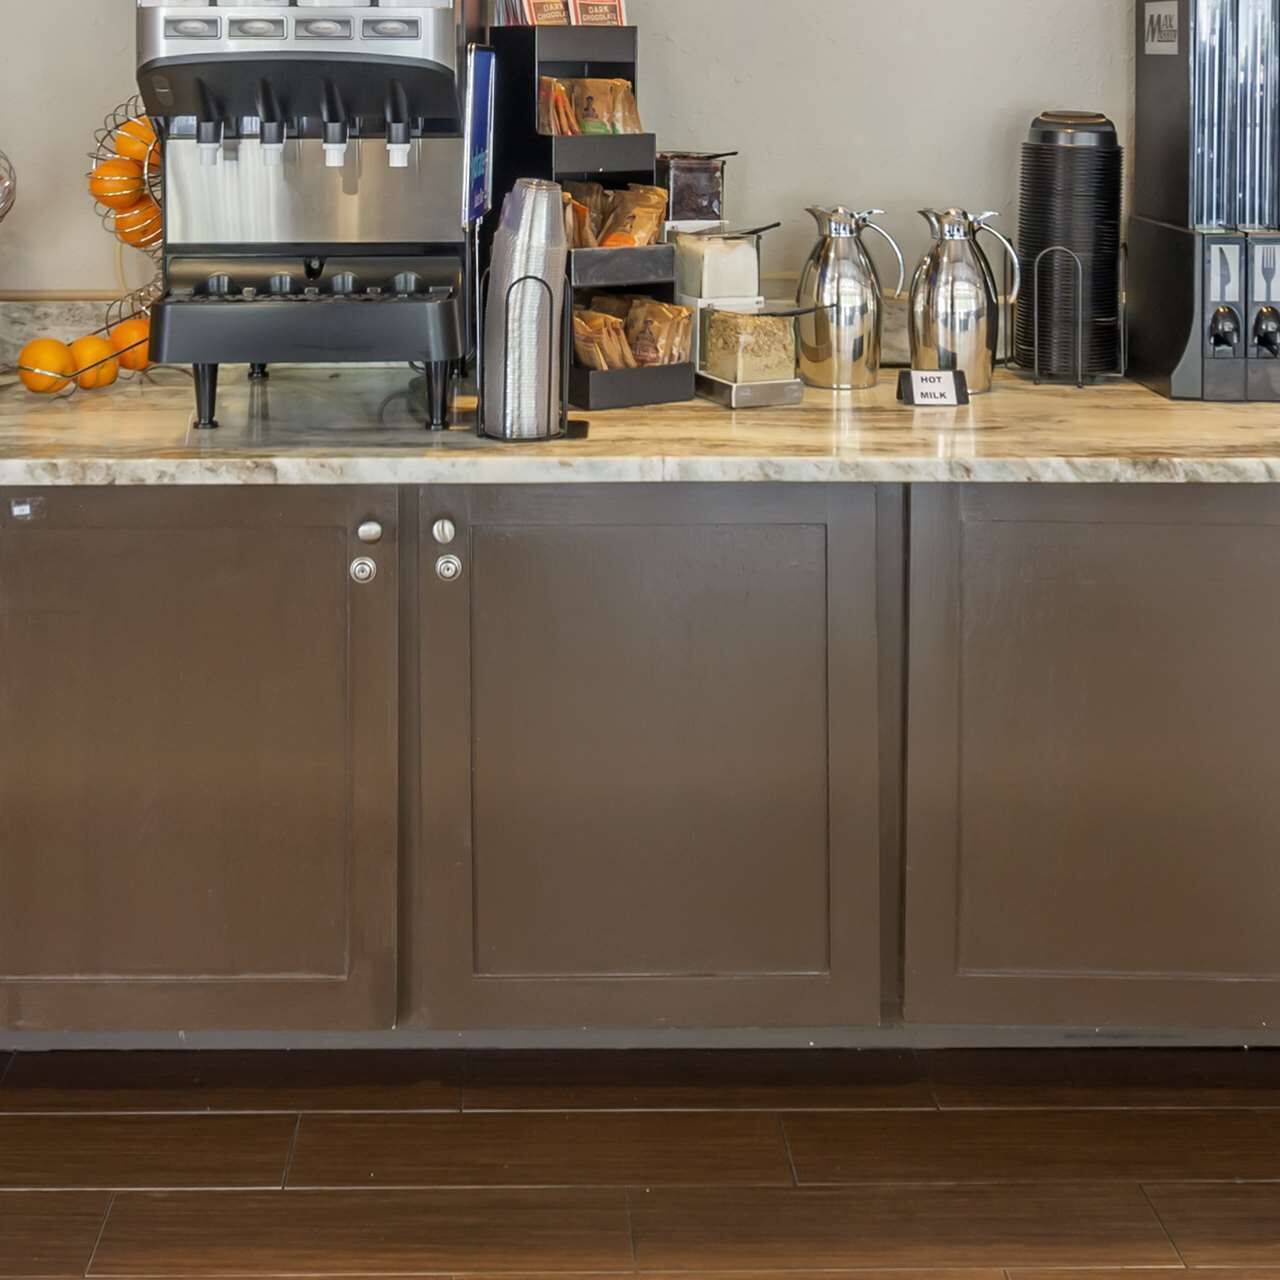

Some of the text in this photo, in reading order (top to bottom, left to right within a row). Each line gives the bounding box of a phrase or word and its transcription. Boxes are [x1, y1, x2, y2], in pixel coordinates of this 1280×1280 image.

[588, 6, 609, 14] DARK
[920, 376, 943, 384] HOT
[920, 391, 947, 399] MILK
